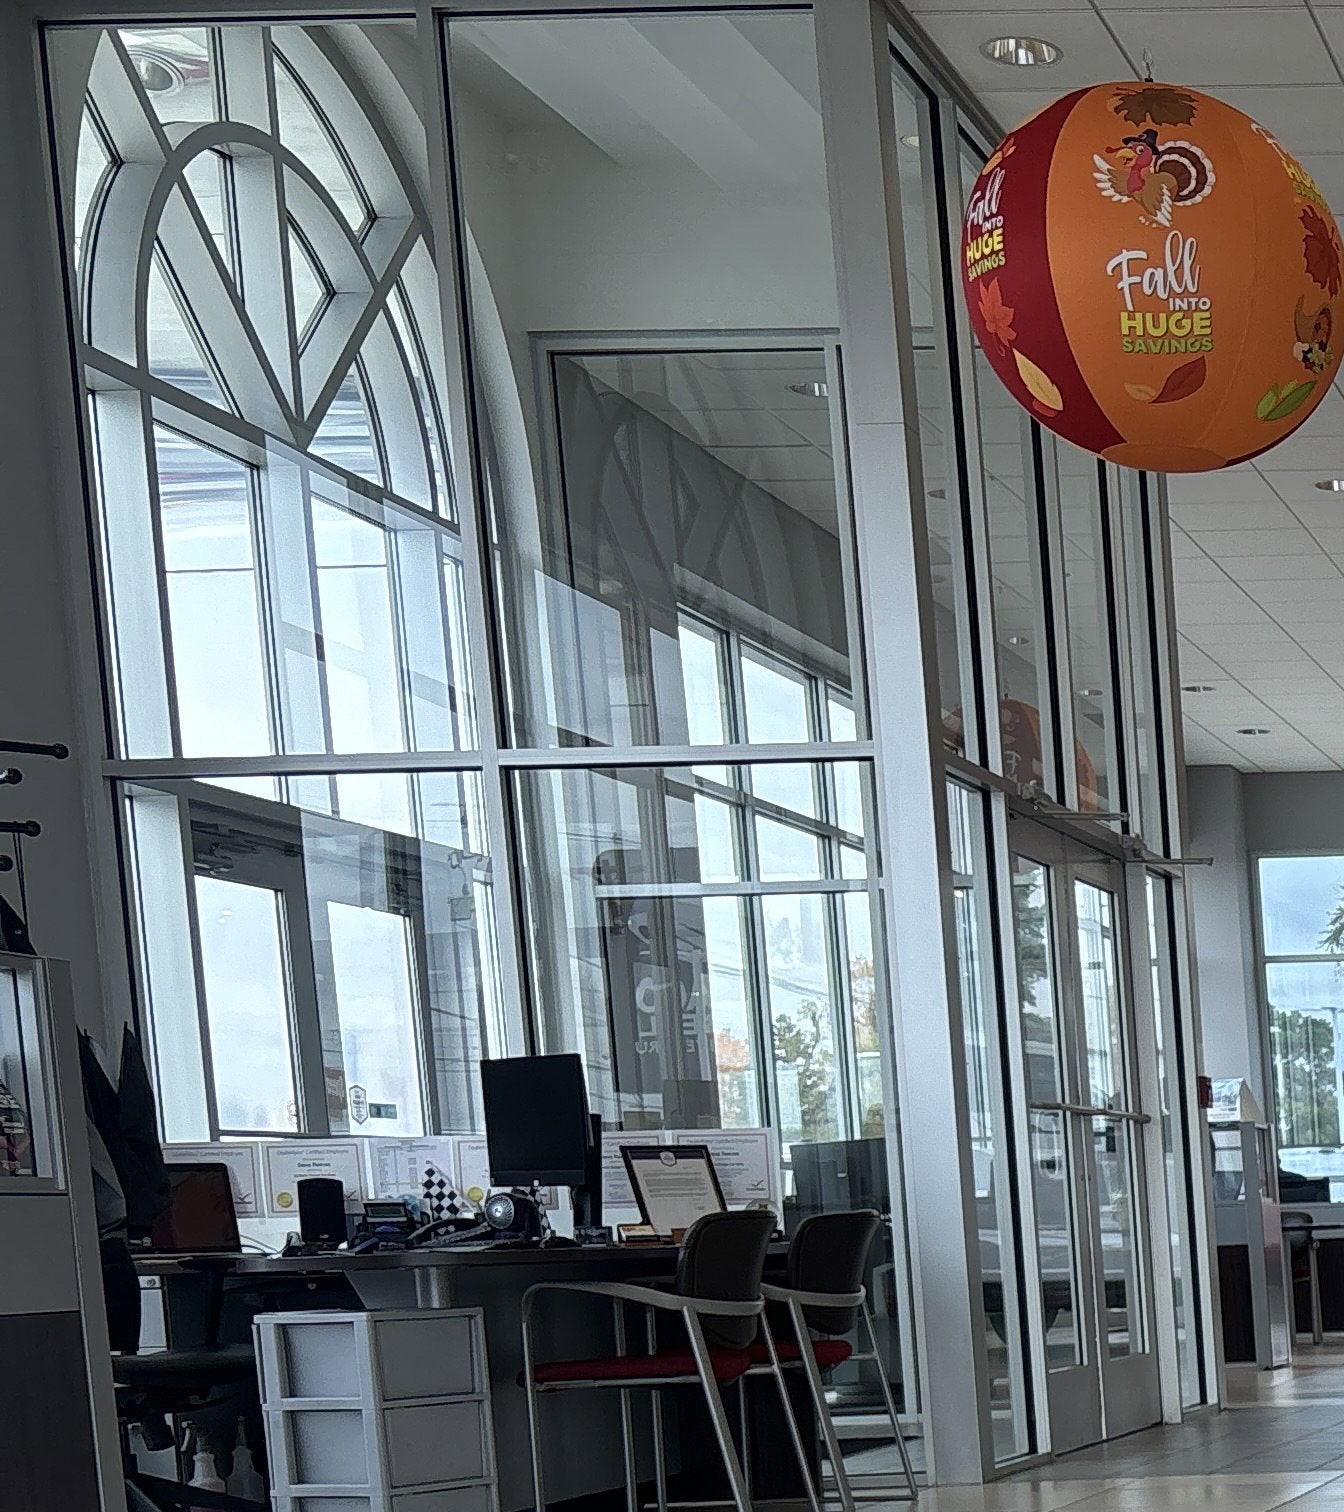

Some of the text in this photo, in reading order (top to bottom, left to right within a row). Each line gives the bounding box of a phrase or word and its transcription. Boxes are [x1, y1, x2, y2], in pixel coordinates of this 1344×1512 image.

[967, 166, 1005, 243] Fall
[982, 215, 1004, 233] INTO
[966, 228, 1004, 266] HUGE
[967, 251, 1006, 282] SAVINGS
[1106, 229, 1201, 311] Fall
[1168, 297, 1211, 311] INTO
[1120, 311, 1212, 337] HUGE
[1122, 336, 1213, 353] SAVINGS
